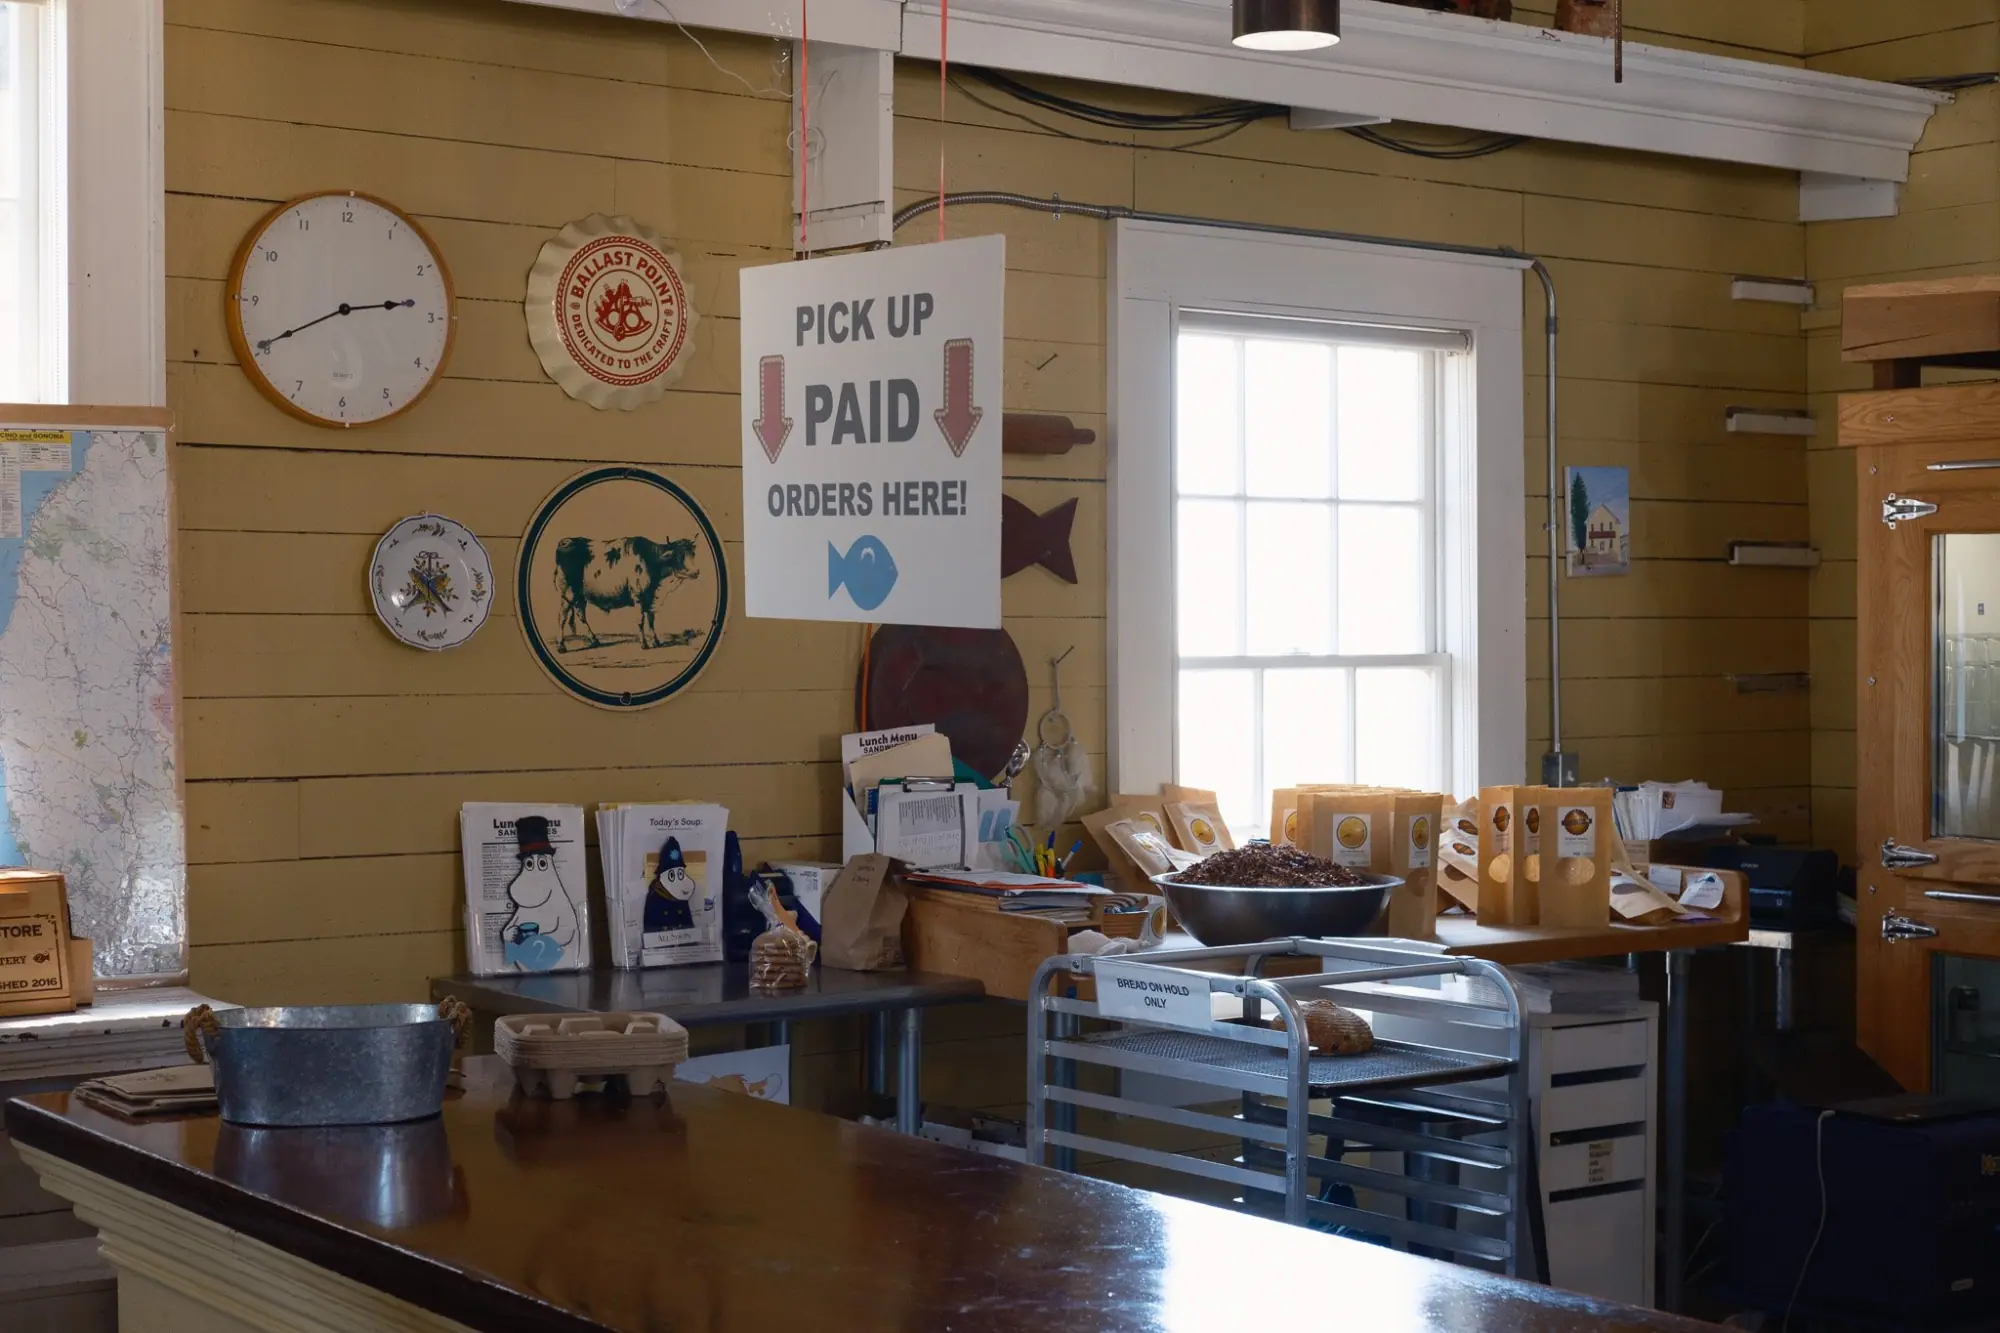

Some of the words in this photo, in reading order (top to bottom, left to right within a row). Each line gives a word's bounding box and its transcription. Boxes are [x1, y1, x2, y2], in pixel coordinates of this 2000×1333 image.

[342, 211, 353, 223] 12
[299, 220, 309, 231] 11
[388, 230, 393, 240] 1
[265, 251, 278, 262] 10
[416, 265, 424, 276] 2
[571, 251, 634, 300] BALLAST
[636, 257, 674, 307] POINT
[252, 295, 259, 306] 9
[428, 313, 435, 324] 3
[796, 298, 875, 347] PICK
[887, 292, 934, 338] UP
[571, 314, 615, 367] DEDICATED
[617, 359, 631, 369] TO
[634, 351, 653, 367] THE
[652, 320, 673, 354] CRAFT
[414, 357, 421, 368] 4
[296, 380, 303, 391] 7
[383, 388, 390, 399] 5
[339, 397, 346, 408] 6
[805, 378, 921, 447] PAID
[768, 482, 872, 517] ORDERS
[883, 480, 967, 516] HERE!
[859, 734, 888, 747] Lunch
[890, 733, 917, 743] Menu
[650, 818, 679, 827] Today's
[681, 818, 703, 827] Soup:
[0, 924, 42, 938] TORE
[32, 978, 57, 987] 2016
[1117, 978, 1147, 991] BREAD
[1149, 982, 1163, 993] ON
[1164, 984, 1190, 996] HOLD
[1144, 996, 1167, 1009] ONLY
